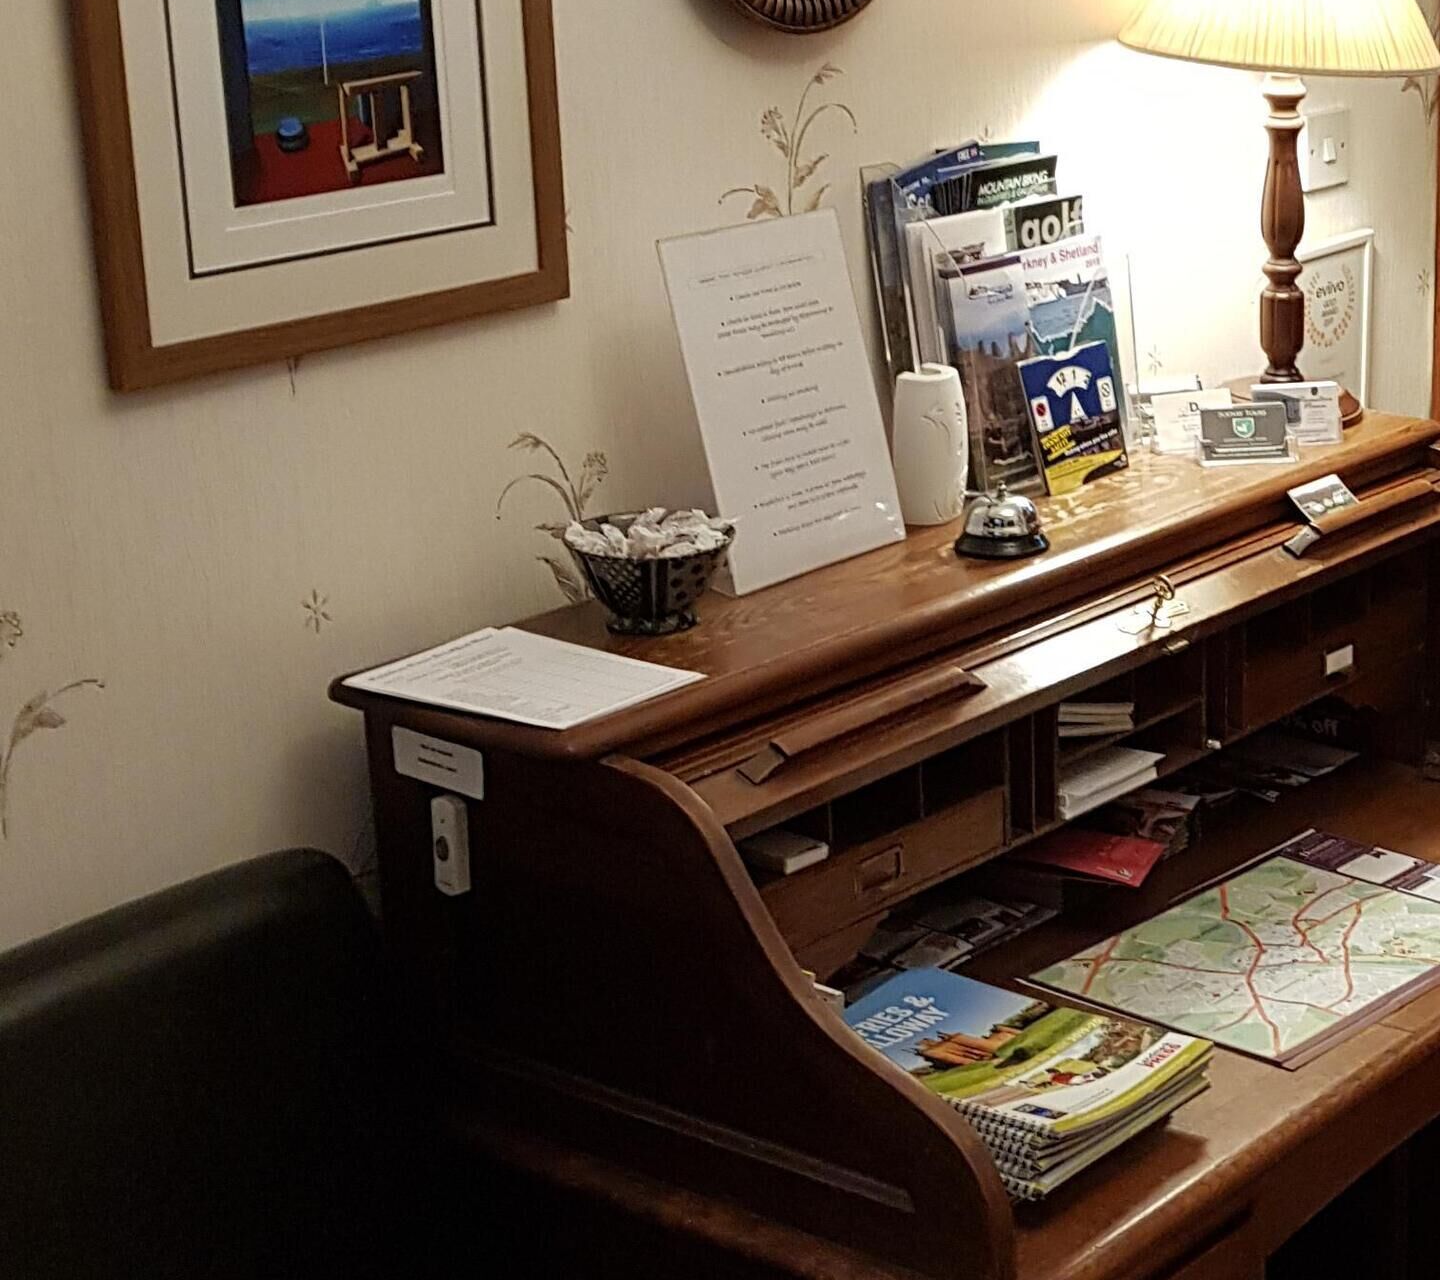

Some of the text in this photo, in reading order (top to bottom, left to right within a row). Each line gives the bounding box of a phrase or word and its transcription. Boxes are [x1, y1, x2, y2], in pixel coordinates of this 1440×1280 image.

[978, 175, 1020, 195] MOUNTAIN
[1022, 242, 1099, 271] rkney & Shetland
[866, 1004, 951, 1050] LLOWAY
